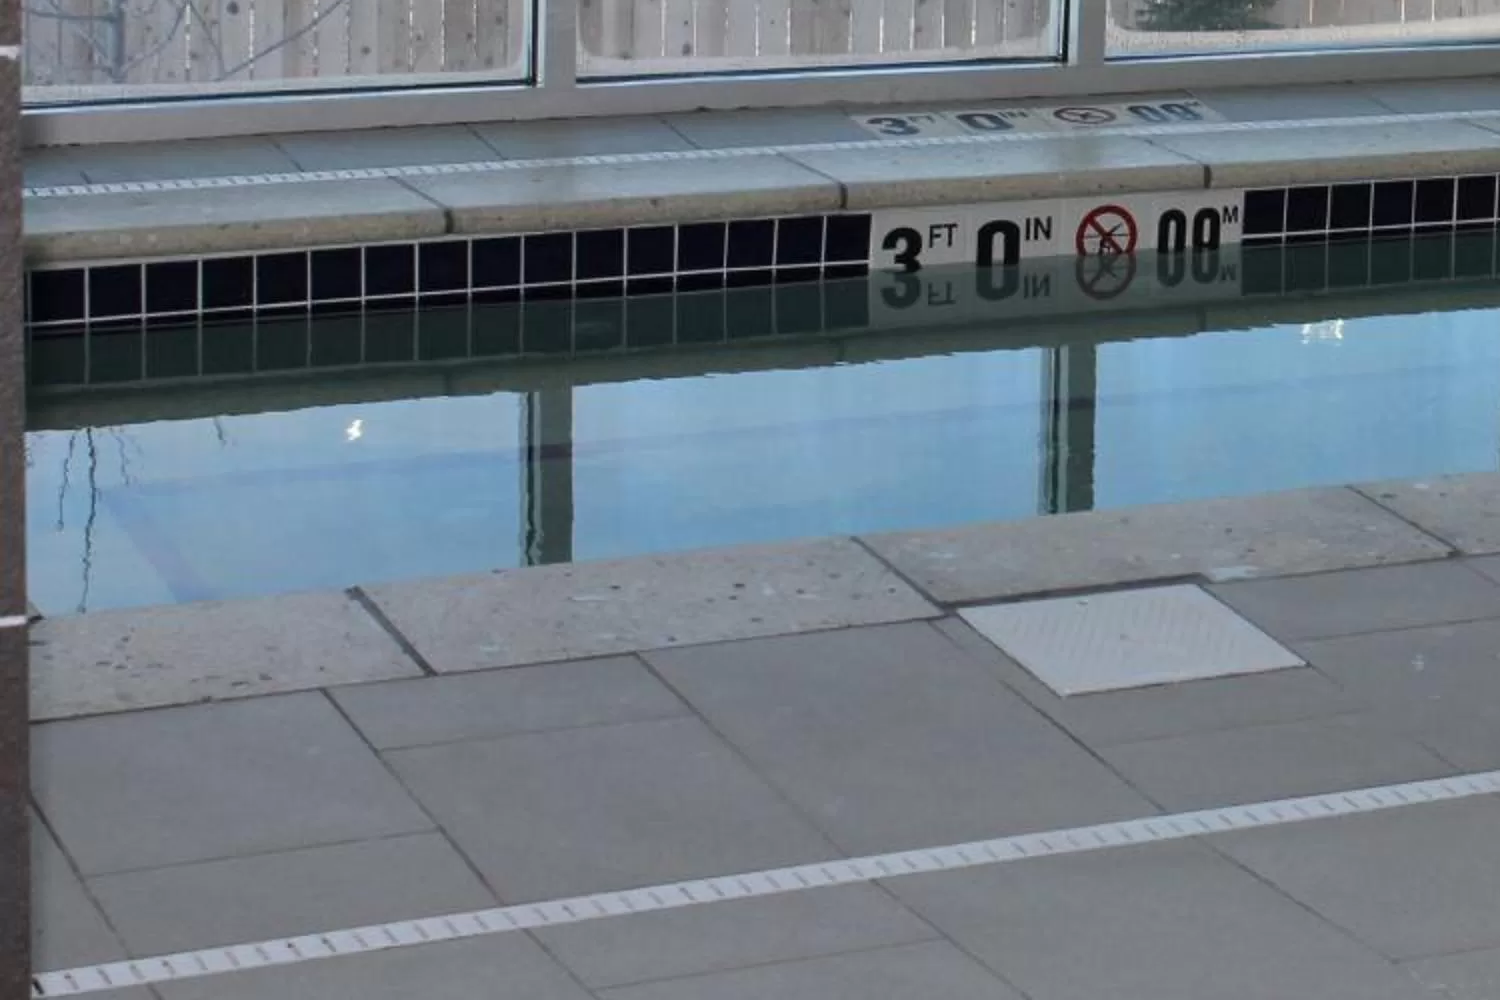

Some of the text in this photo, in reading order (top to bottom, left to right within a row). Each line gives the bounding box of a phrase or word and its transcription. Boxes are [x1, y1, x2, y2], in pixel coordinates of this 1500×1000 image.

[882, 227, 922, 272] 3
[929, 222, 958, 249] FT
[1025, 216, 1052, 241] IN
[1223, 204, 1238, 224] M
